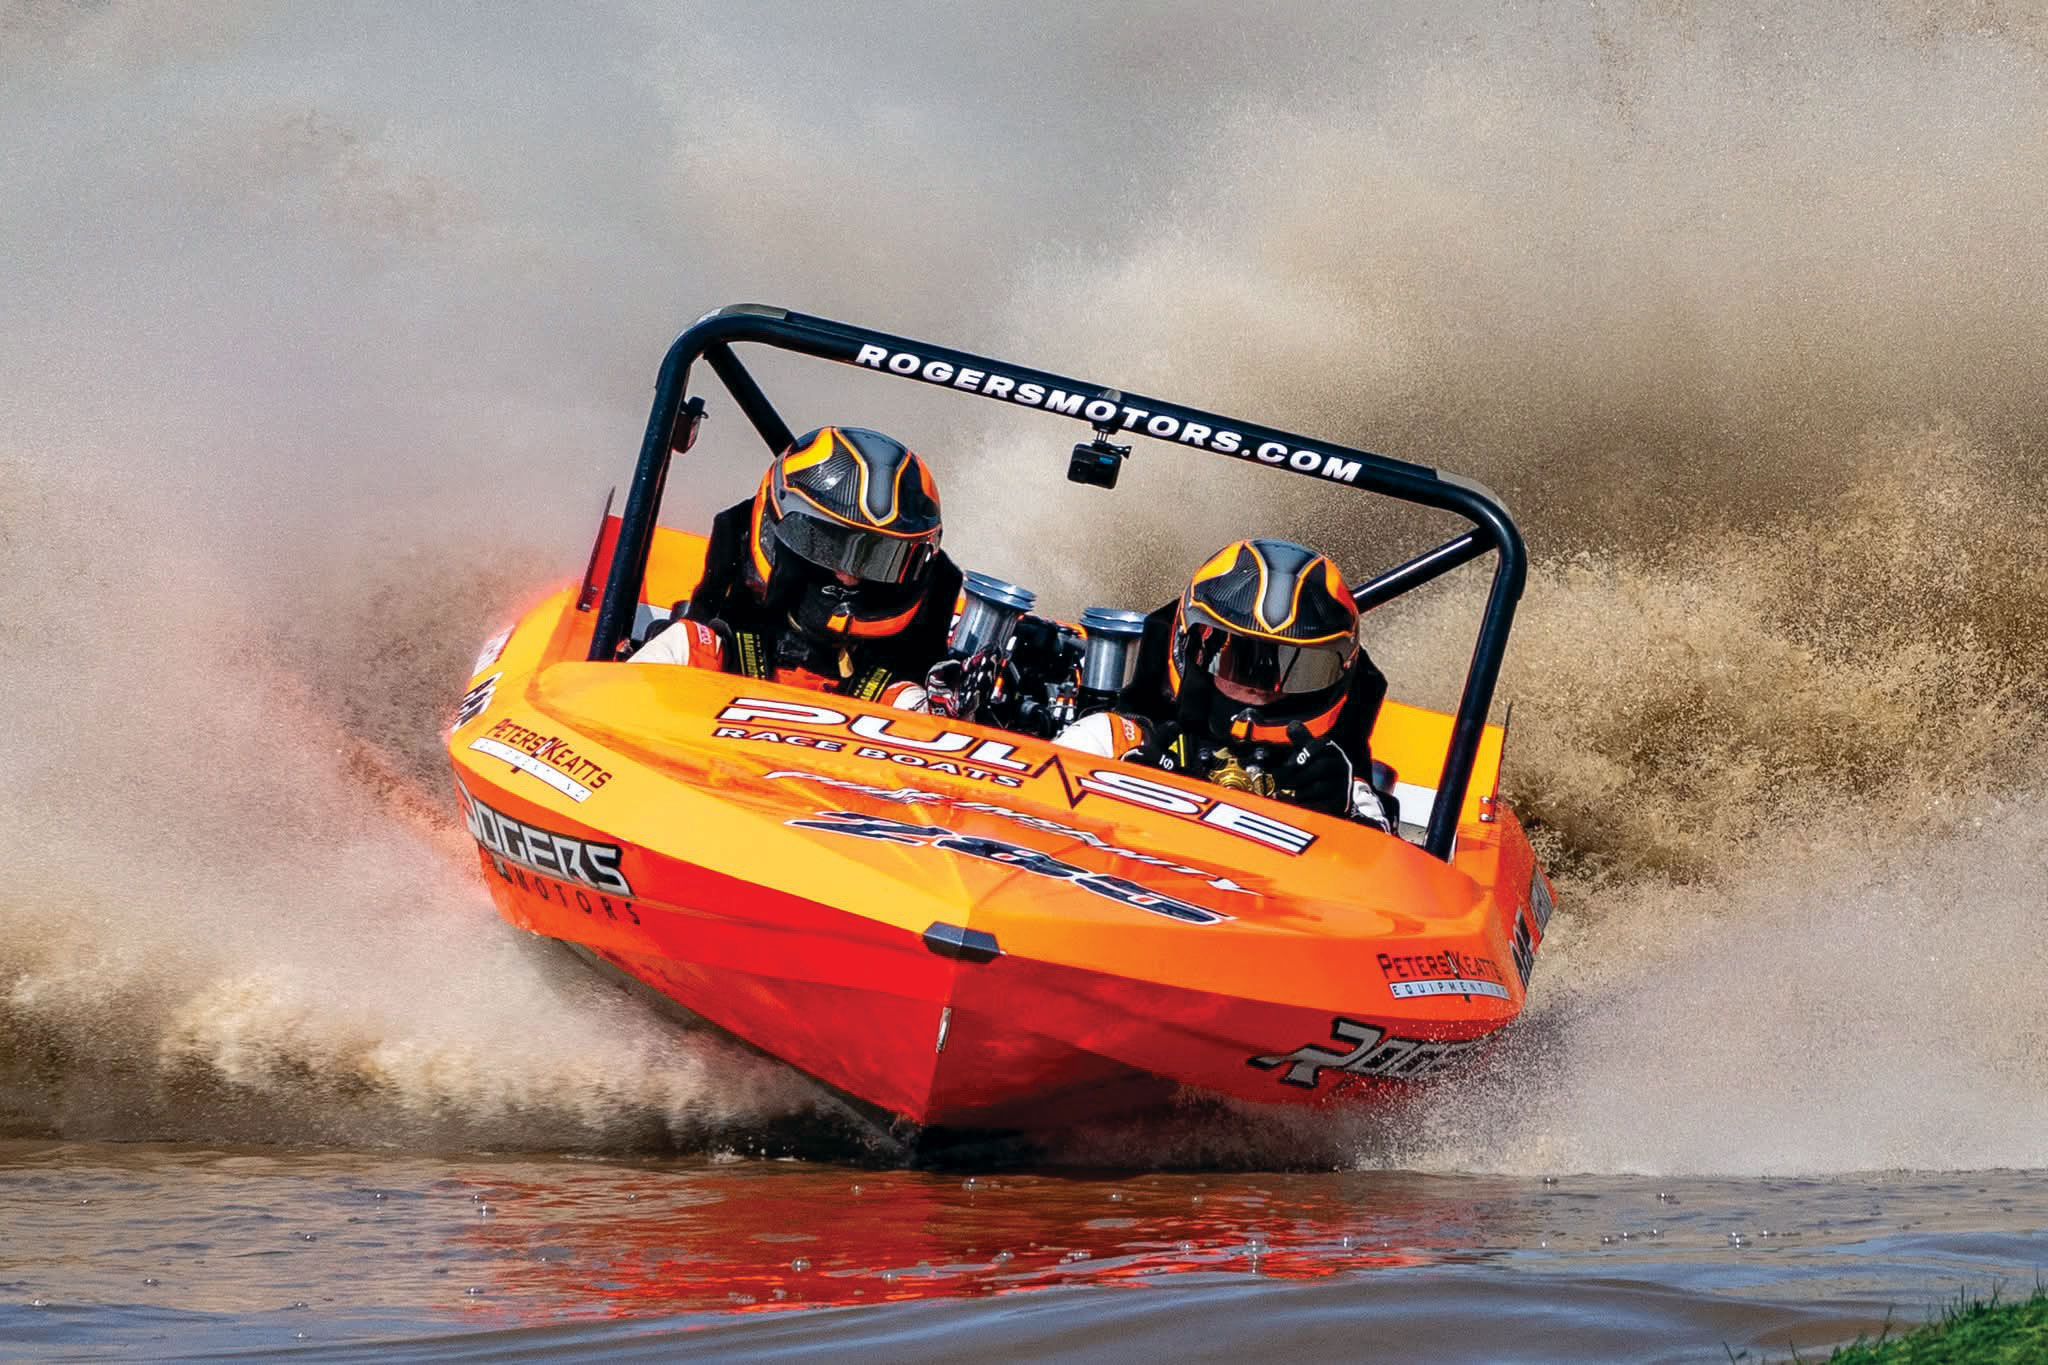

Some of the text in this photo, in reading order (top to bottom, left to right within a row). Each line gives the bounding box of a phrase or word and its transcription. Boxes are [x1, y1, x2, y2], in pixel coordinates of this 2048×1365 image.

[855, 343, 1363, 482] ROGERSMOTORS.COM
[486, 717, 546, 753] PETERS
[541, 736, 613, 789] KEATTS
[714, 726, 1022, 788] RACE BOATS
[514, 868, 641, 926] MOTORS
[1376, 953, 1451, 979] PETERS
[1391, 982, 1486, 996] EQUIPMENT
